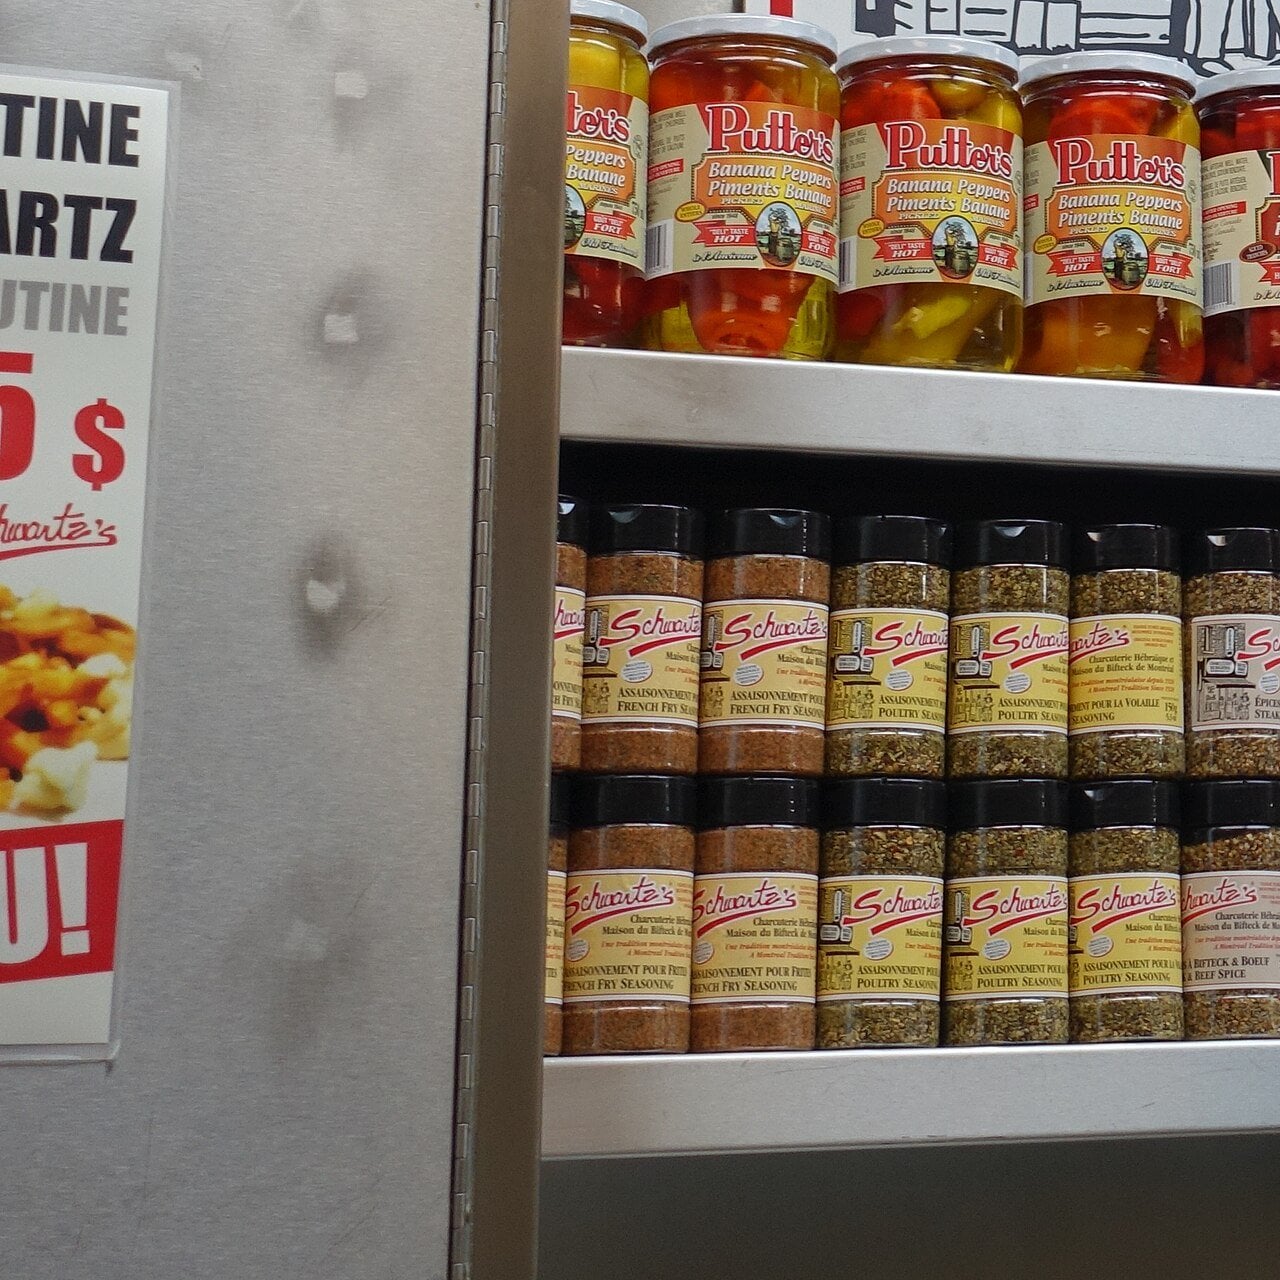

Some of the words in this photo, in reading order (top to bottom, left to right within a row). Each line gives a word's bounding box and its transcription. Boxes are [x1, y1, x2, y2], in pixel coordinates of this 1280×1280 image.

[704, 103, 833, 165] Putter's
[885, 121, 1013, 178] Putter's
[1053, 137, 1185, 187] Putter's
[708, 162, 777, 178] Banana
[780, 164, 831, 190] Peppers
[707, 180, 779, 198] Piments
[783, 184, 831, 208] Banane
[887, 177, 953, 194] Banana
[956, 180, 1010, 202] Peppers
[886, 196, 957, 213] Piments
[961, 201, 1010, 220] Banane
[1058, 191, 1121, 209] Banana
[1125, 192, 1182, 212] Peppers
[1058, 209, 1124, 226] Piments
[1129, 212, 1182, 230] Banane
[714, 233, 741, 244] HOT
[1063, 262, 1090, 272] HOT
[730, 703, 768, 715] FRENCH
[771, 702, 793, 715] FRY
[1091, 698, 1112, 709] POUR
[1114, 698, 1122, 708] LA
[1125, 697, 1160, 708] VOLAILLE
[1083, 972, 1121, 986] POULTRY
[1125, 971, 1170, 984] SEASONING
[1195, 968, 1218, 980] BEEF
[1221, 968, 1246, 979] SPICE
[722, 979, 741, 991] FRY
[744, 979, 798, 991] SEASONING
